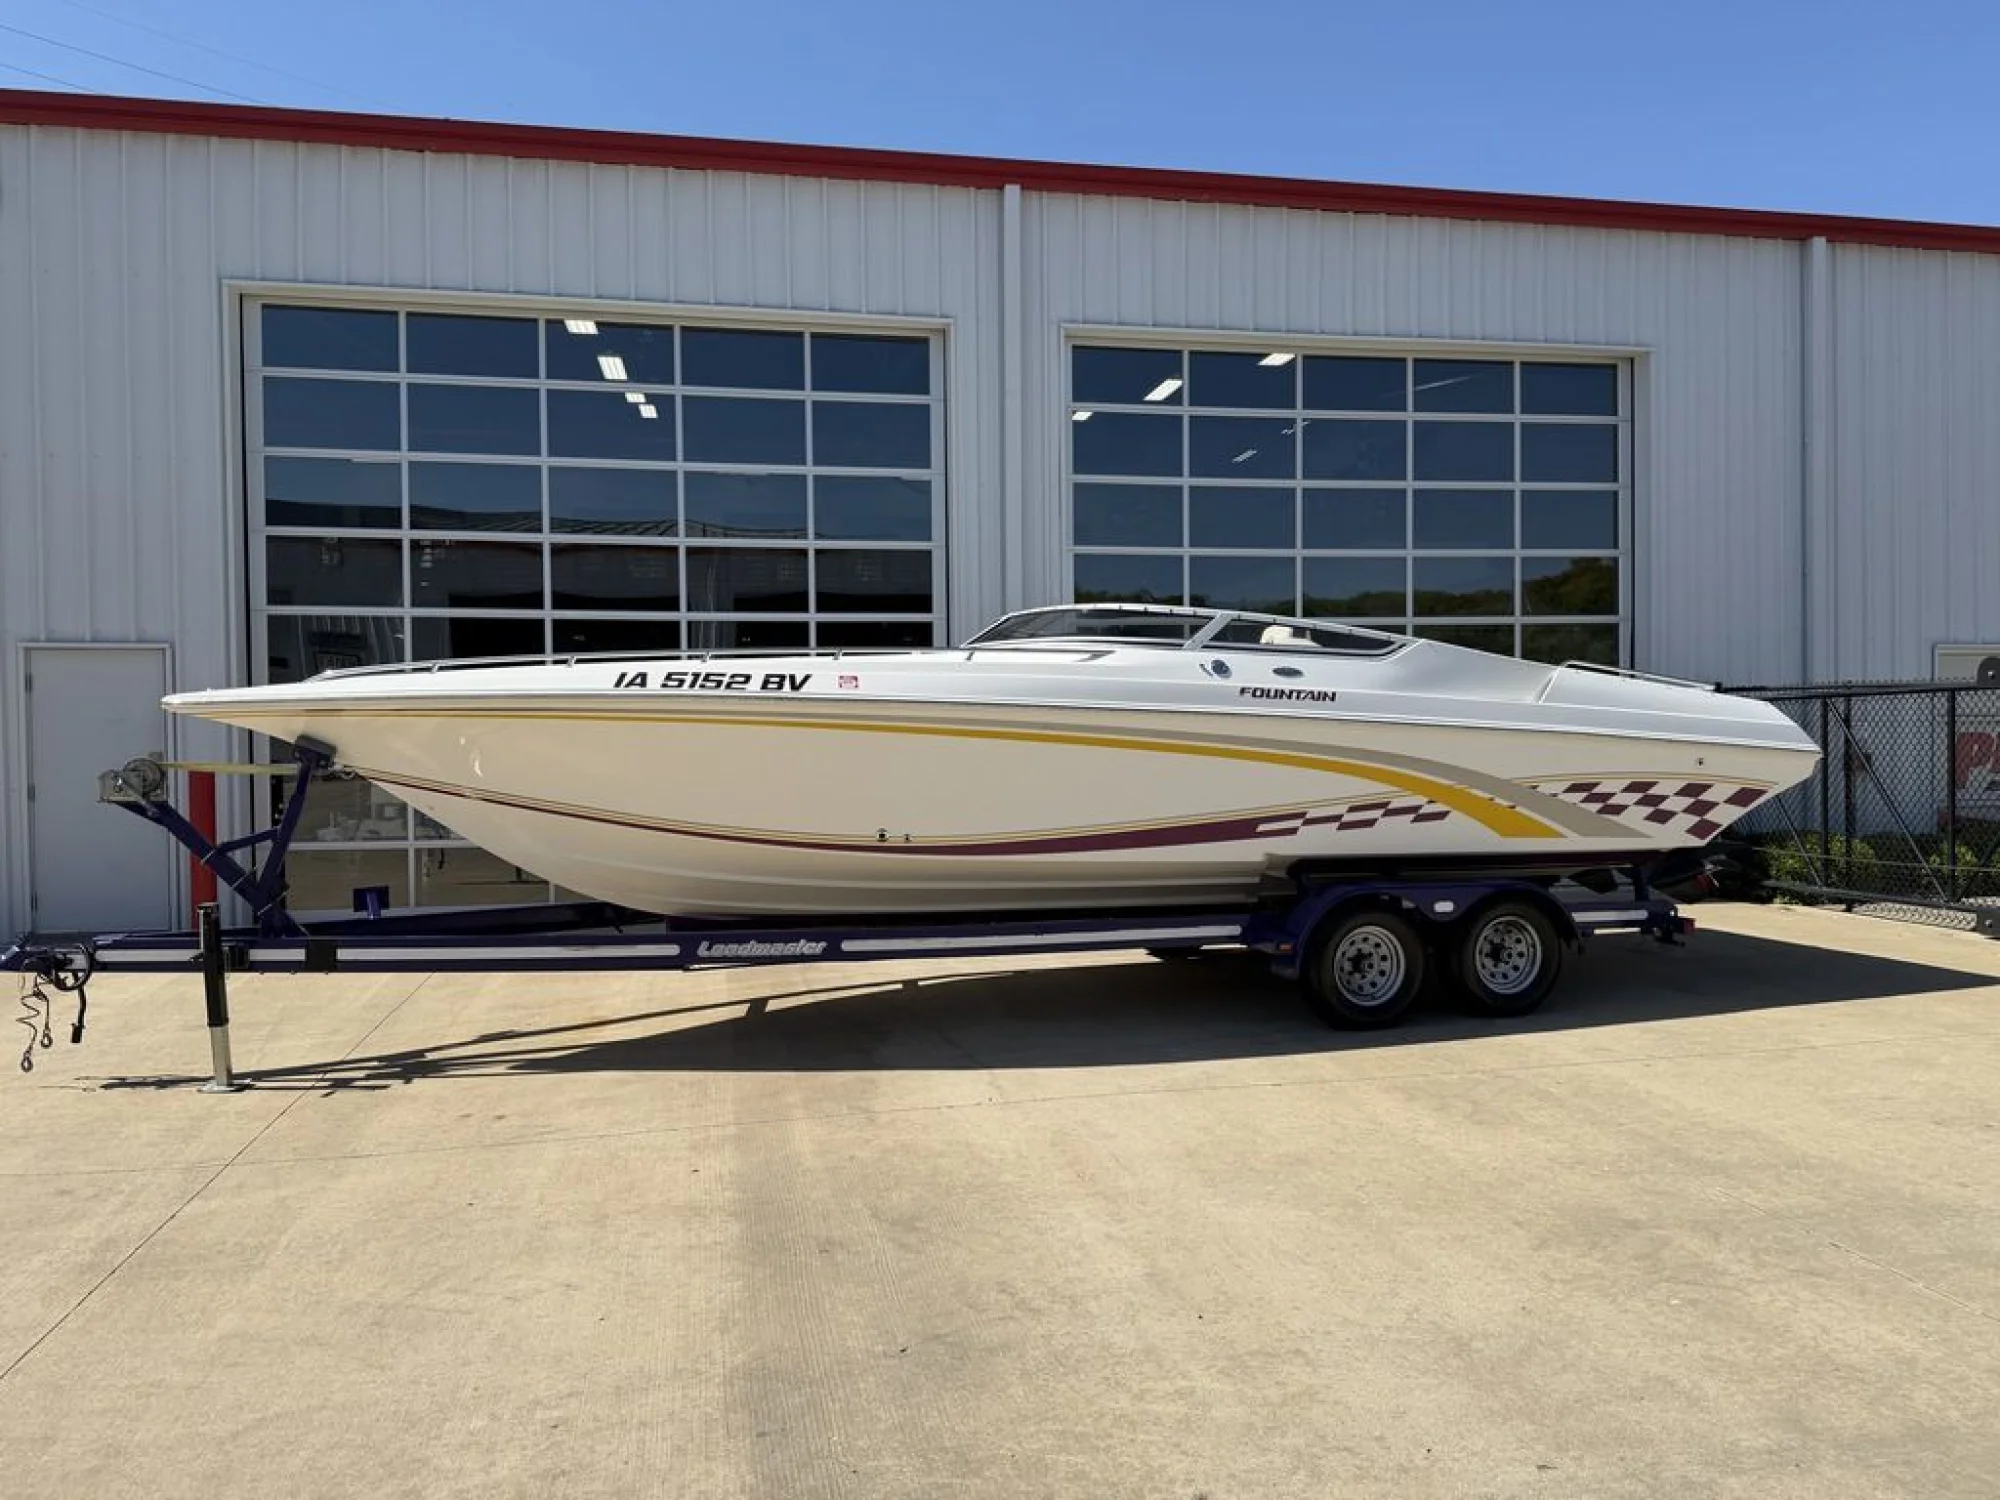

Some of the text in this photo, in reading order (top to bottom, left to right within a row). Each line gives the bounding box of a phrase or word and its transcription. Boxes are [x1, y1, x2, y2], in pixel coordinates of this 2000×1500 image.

[613, 671, 813, 692] IA 5152 BV
[1239, 686, 1337, 702] FOUNTAIN
[697, 938, 828, 958] Loadmaster
